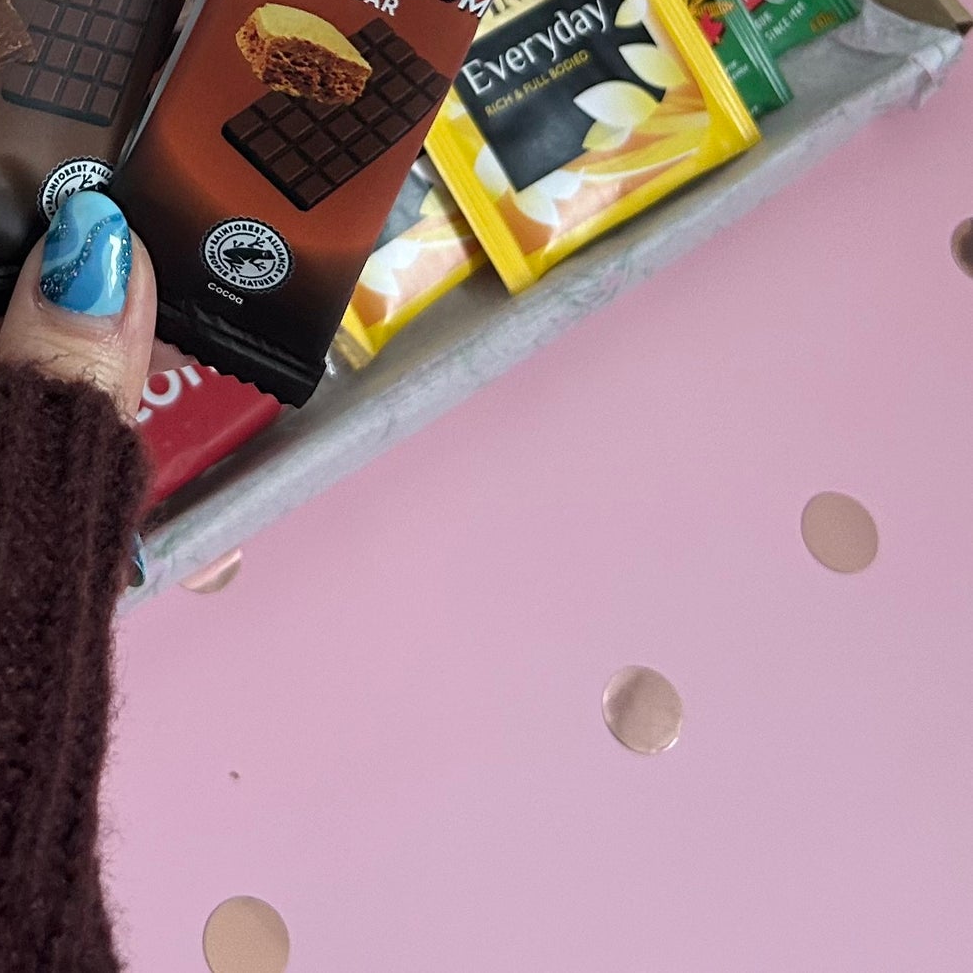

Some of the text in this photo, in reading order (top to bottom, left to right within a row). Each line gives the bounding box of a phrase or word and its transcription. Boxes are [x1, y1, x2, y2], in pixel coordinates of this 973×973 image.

[484, 49, 591, 118] RICH & FULL BODIED
[45, 164, 88, 205] RAINFOREST
[208, 250, 230, 277] PEOPLE
[239, 275, 276, 288] NATURE
[210, 224, 287, 275] RAINFOREST ALLIANCE
